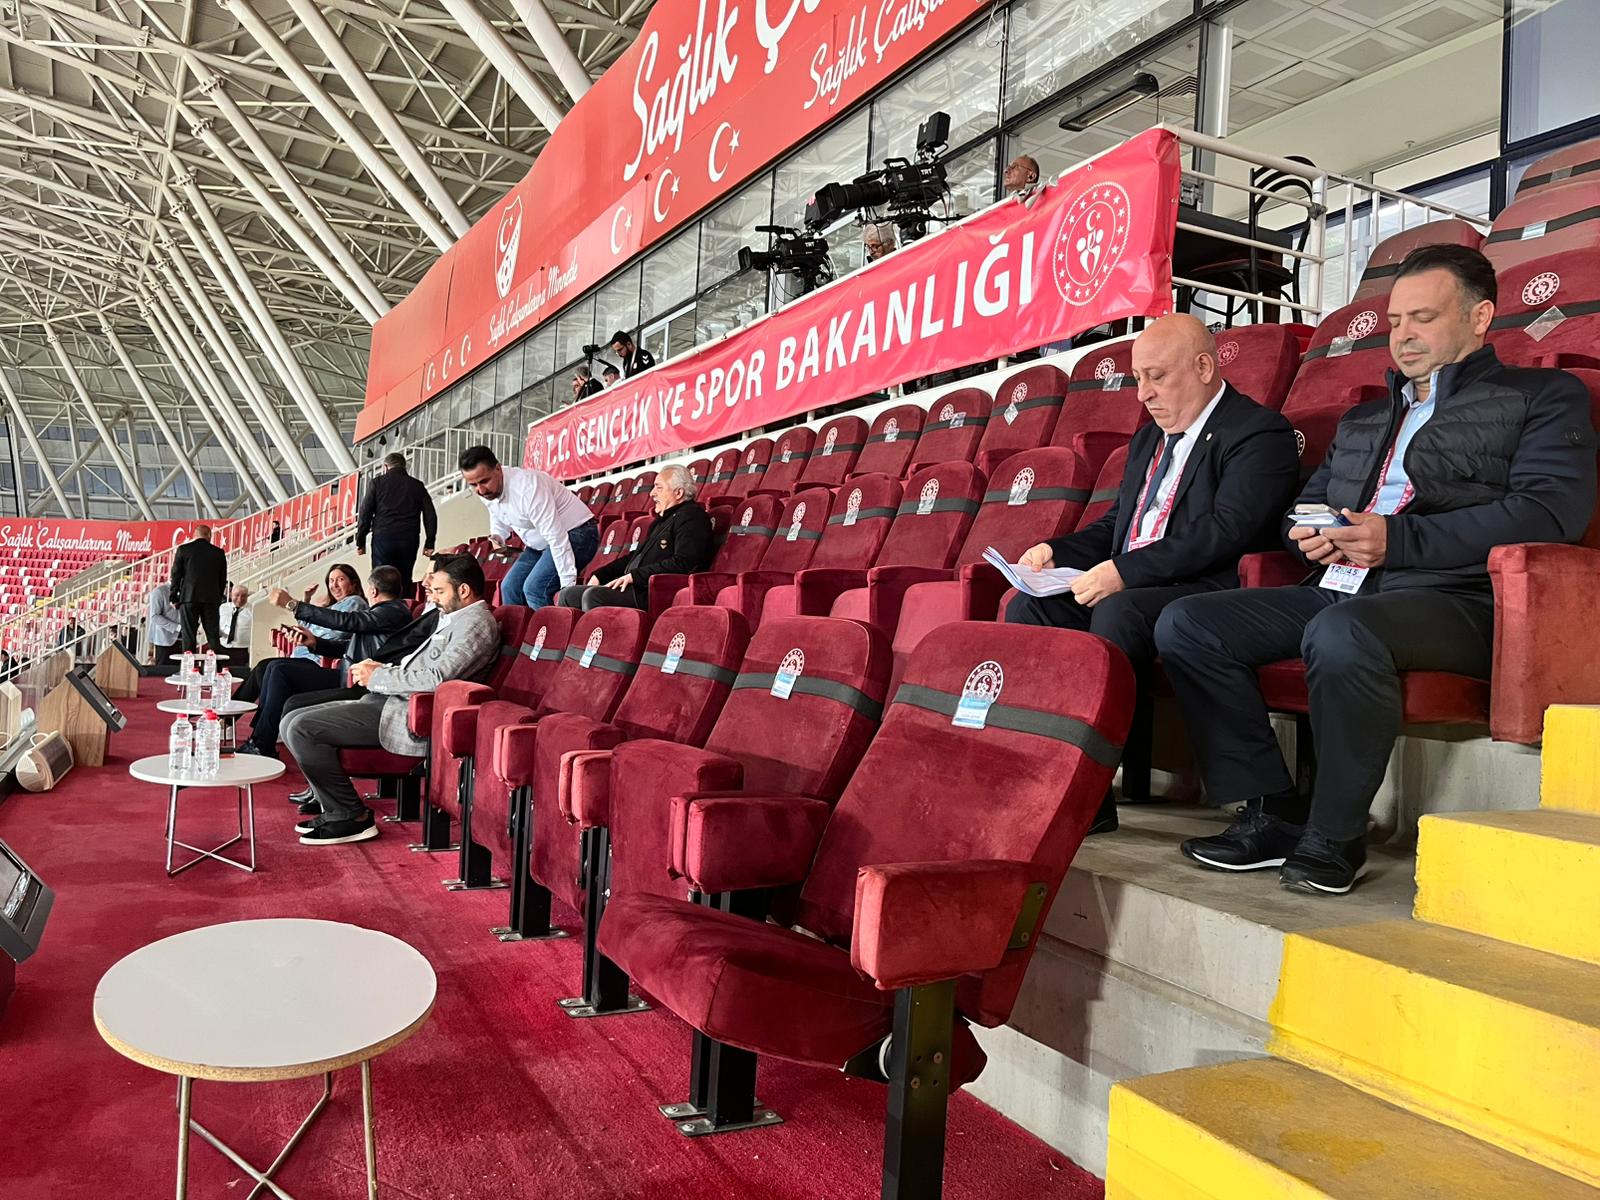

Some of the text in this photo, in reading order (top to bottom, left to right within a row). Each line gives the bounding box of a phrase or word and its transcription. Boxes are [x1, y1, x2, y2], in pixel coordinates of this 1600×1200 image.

[623, 0, 739, 182] Sağlık
[803, 5, 867, 110] Sağlık
[546, 231, 1035, 468] T.C. GENÇLİK VE SPOR BAKANLIĞI
[0, 525, 34, 550] Sağlık
[36, 526, 112, 551] Çalışanlarına
